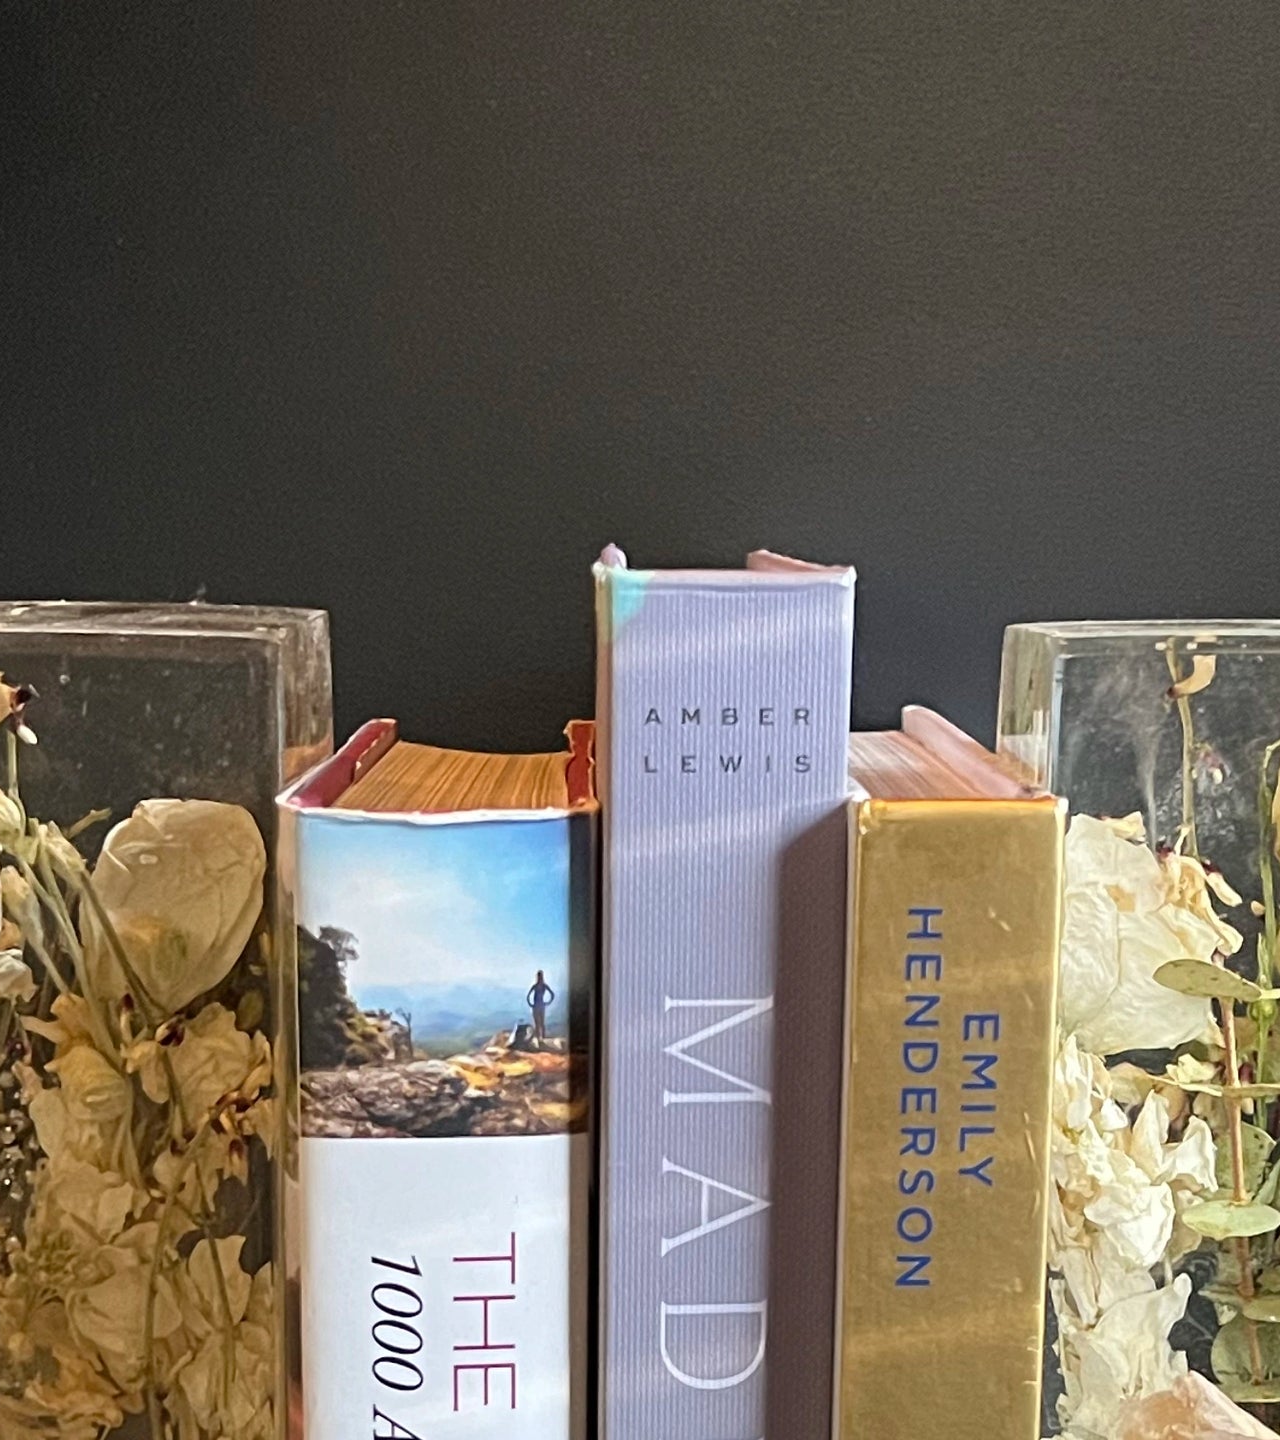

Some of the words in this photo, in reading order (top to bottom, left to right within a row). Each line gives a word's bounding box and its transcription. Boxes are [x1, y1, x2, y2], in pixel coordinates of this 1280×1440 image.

[644, 753, 812, 775] LEWIS
[645, 706, 811, 727] AMBER
[894, 907, 944, 1289] HENDERSON
[957, 1012, 1000, 1188] EMILY
[369, 1253, 424, 1393] 1000
[452, 1231, 517, 1413] THE
